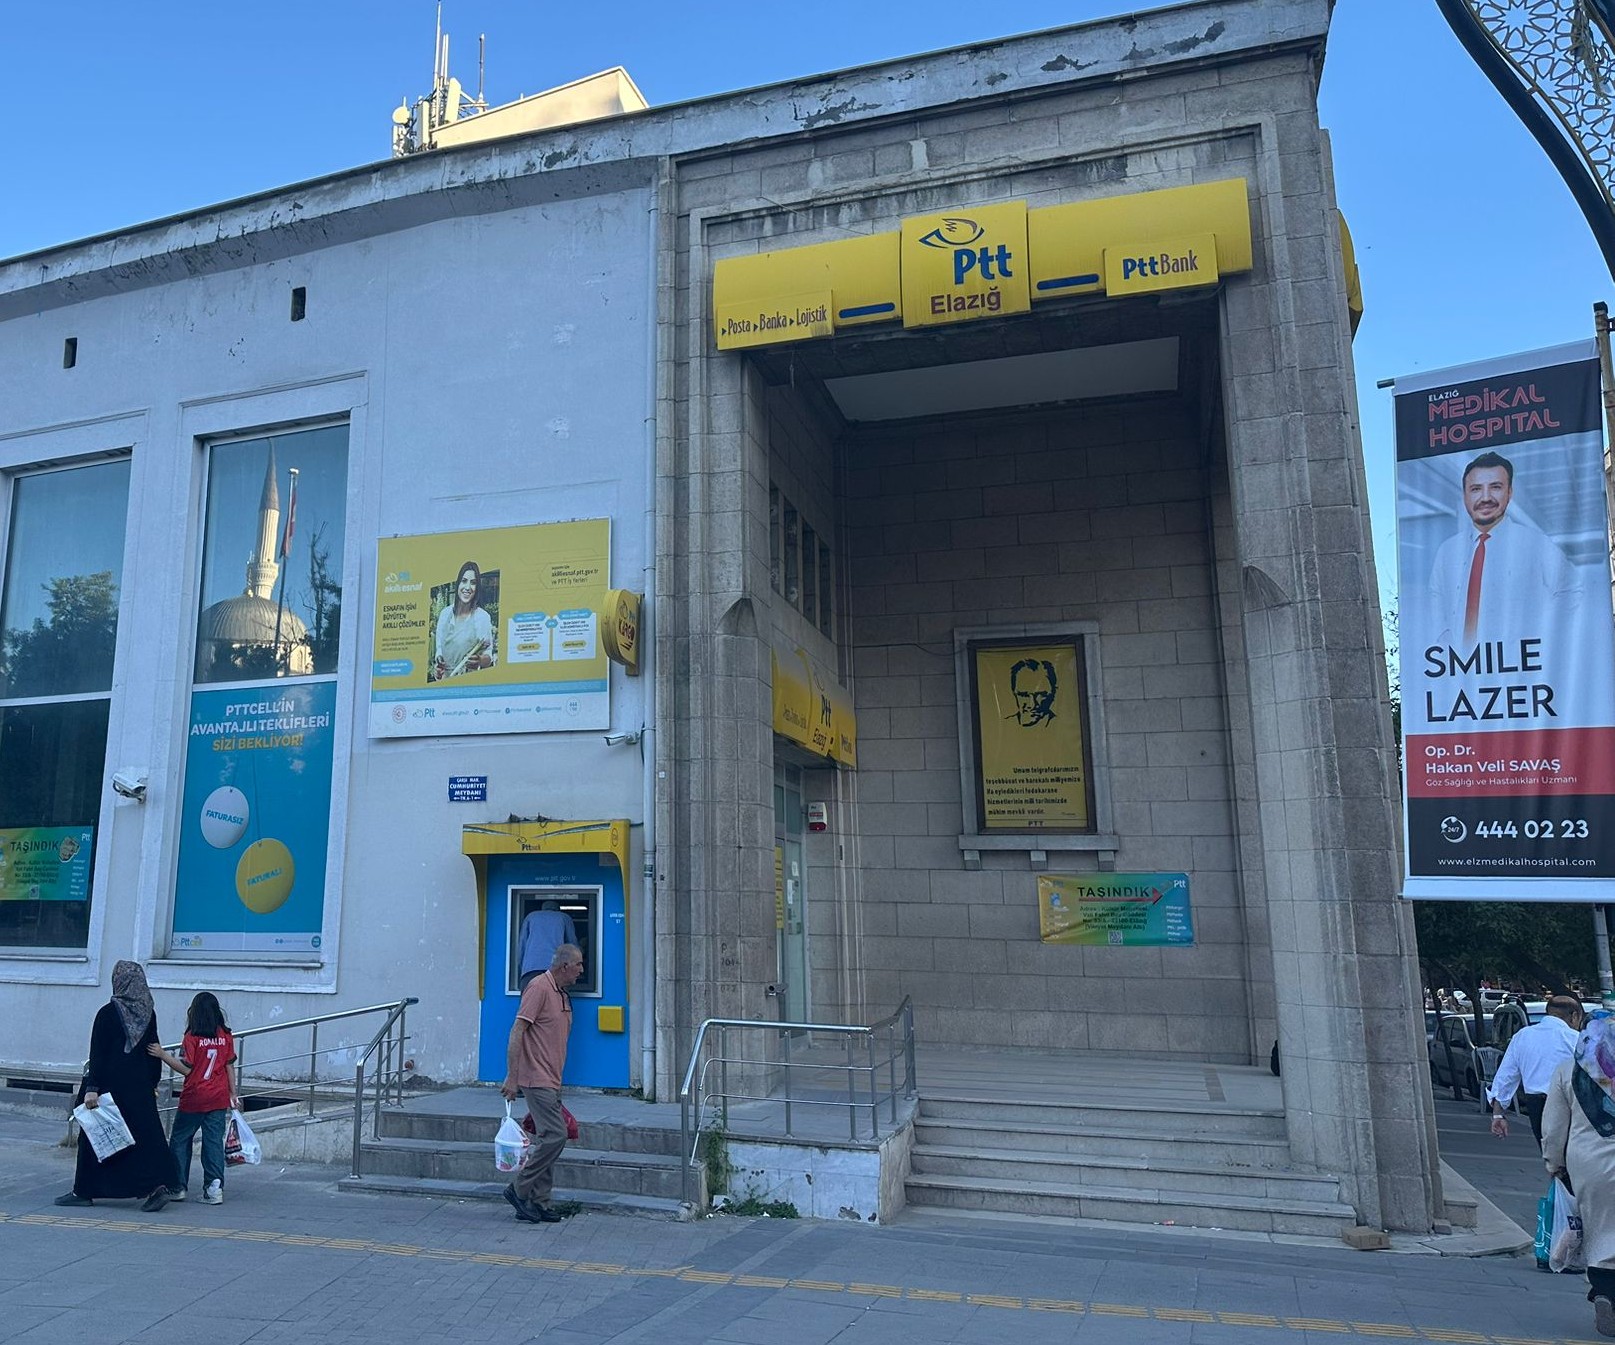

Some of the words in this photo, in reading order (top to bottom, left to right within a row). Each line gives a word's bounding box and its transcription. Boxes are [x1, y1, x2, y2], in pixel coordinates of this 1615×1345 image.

[954, 244, 1013, 285] Ptt
[1122, 250, 1199, 280] PttBank
[930, 286, 1001, 315] Elazığ
[727, 316, 752, 336] Posta
[759, 312, 788, 332] Banka
[796, 305, 827, 331] Lojistik
[1428, 384, 1546, 422] MEDİKAL
[1429, 409, 1560, 448] HOSPITAL
[1424, 638, 1543, 679] SMILE
[424, 708, 435, 718] Ptt
[1425, 684, 1559, 723] LAZER
[190, 721, 257, 736] AVANTAJLI
[258, 711, 330, 732] TEKLİFLERİ
[212, 736, 236, 751] SİZİ
[238, 733, 304, 750] BEKLİYOR!
[1425, 745, 1450, 759] Op.
[1454, 744, 1476, 756] Dr.
[1425, 761, 1473, 774] Hakan
[1478, 760, 1505, 772] Veli
[1509, 758, 1561, 774] SAVAŞ
[1542, 774, 1577, 785] Uzmanı
[205, 809, 244, 825] FATURASIZ
[1475, 819, 1518, 839] 444
[1524, 819, 1554, 839] 02
[1561, 819, 1589, 839] 23
[10, 840, 60, 853] TAŞINDIK
[1438, 856, 1597, 868] www.elzmedikalhospital.com
[1173, 880, 1186, 888] Ptt
[200, 1037, 226, 1048] RONALDO
[204, 1048, 218, 1080] 7
